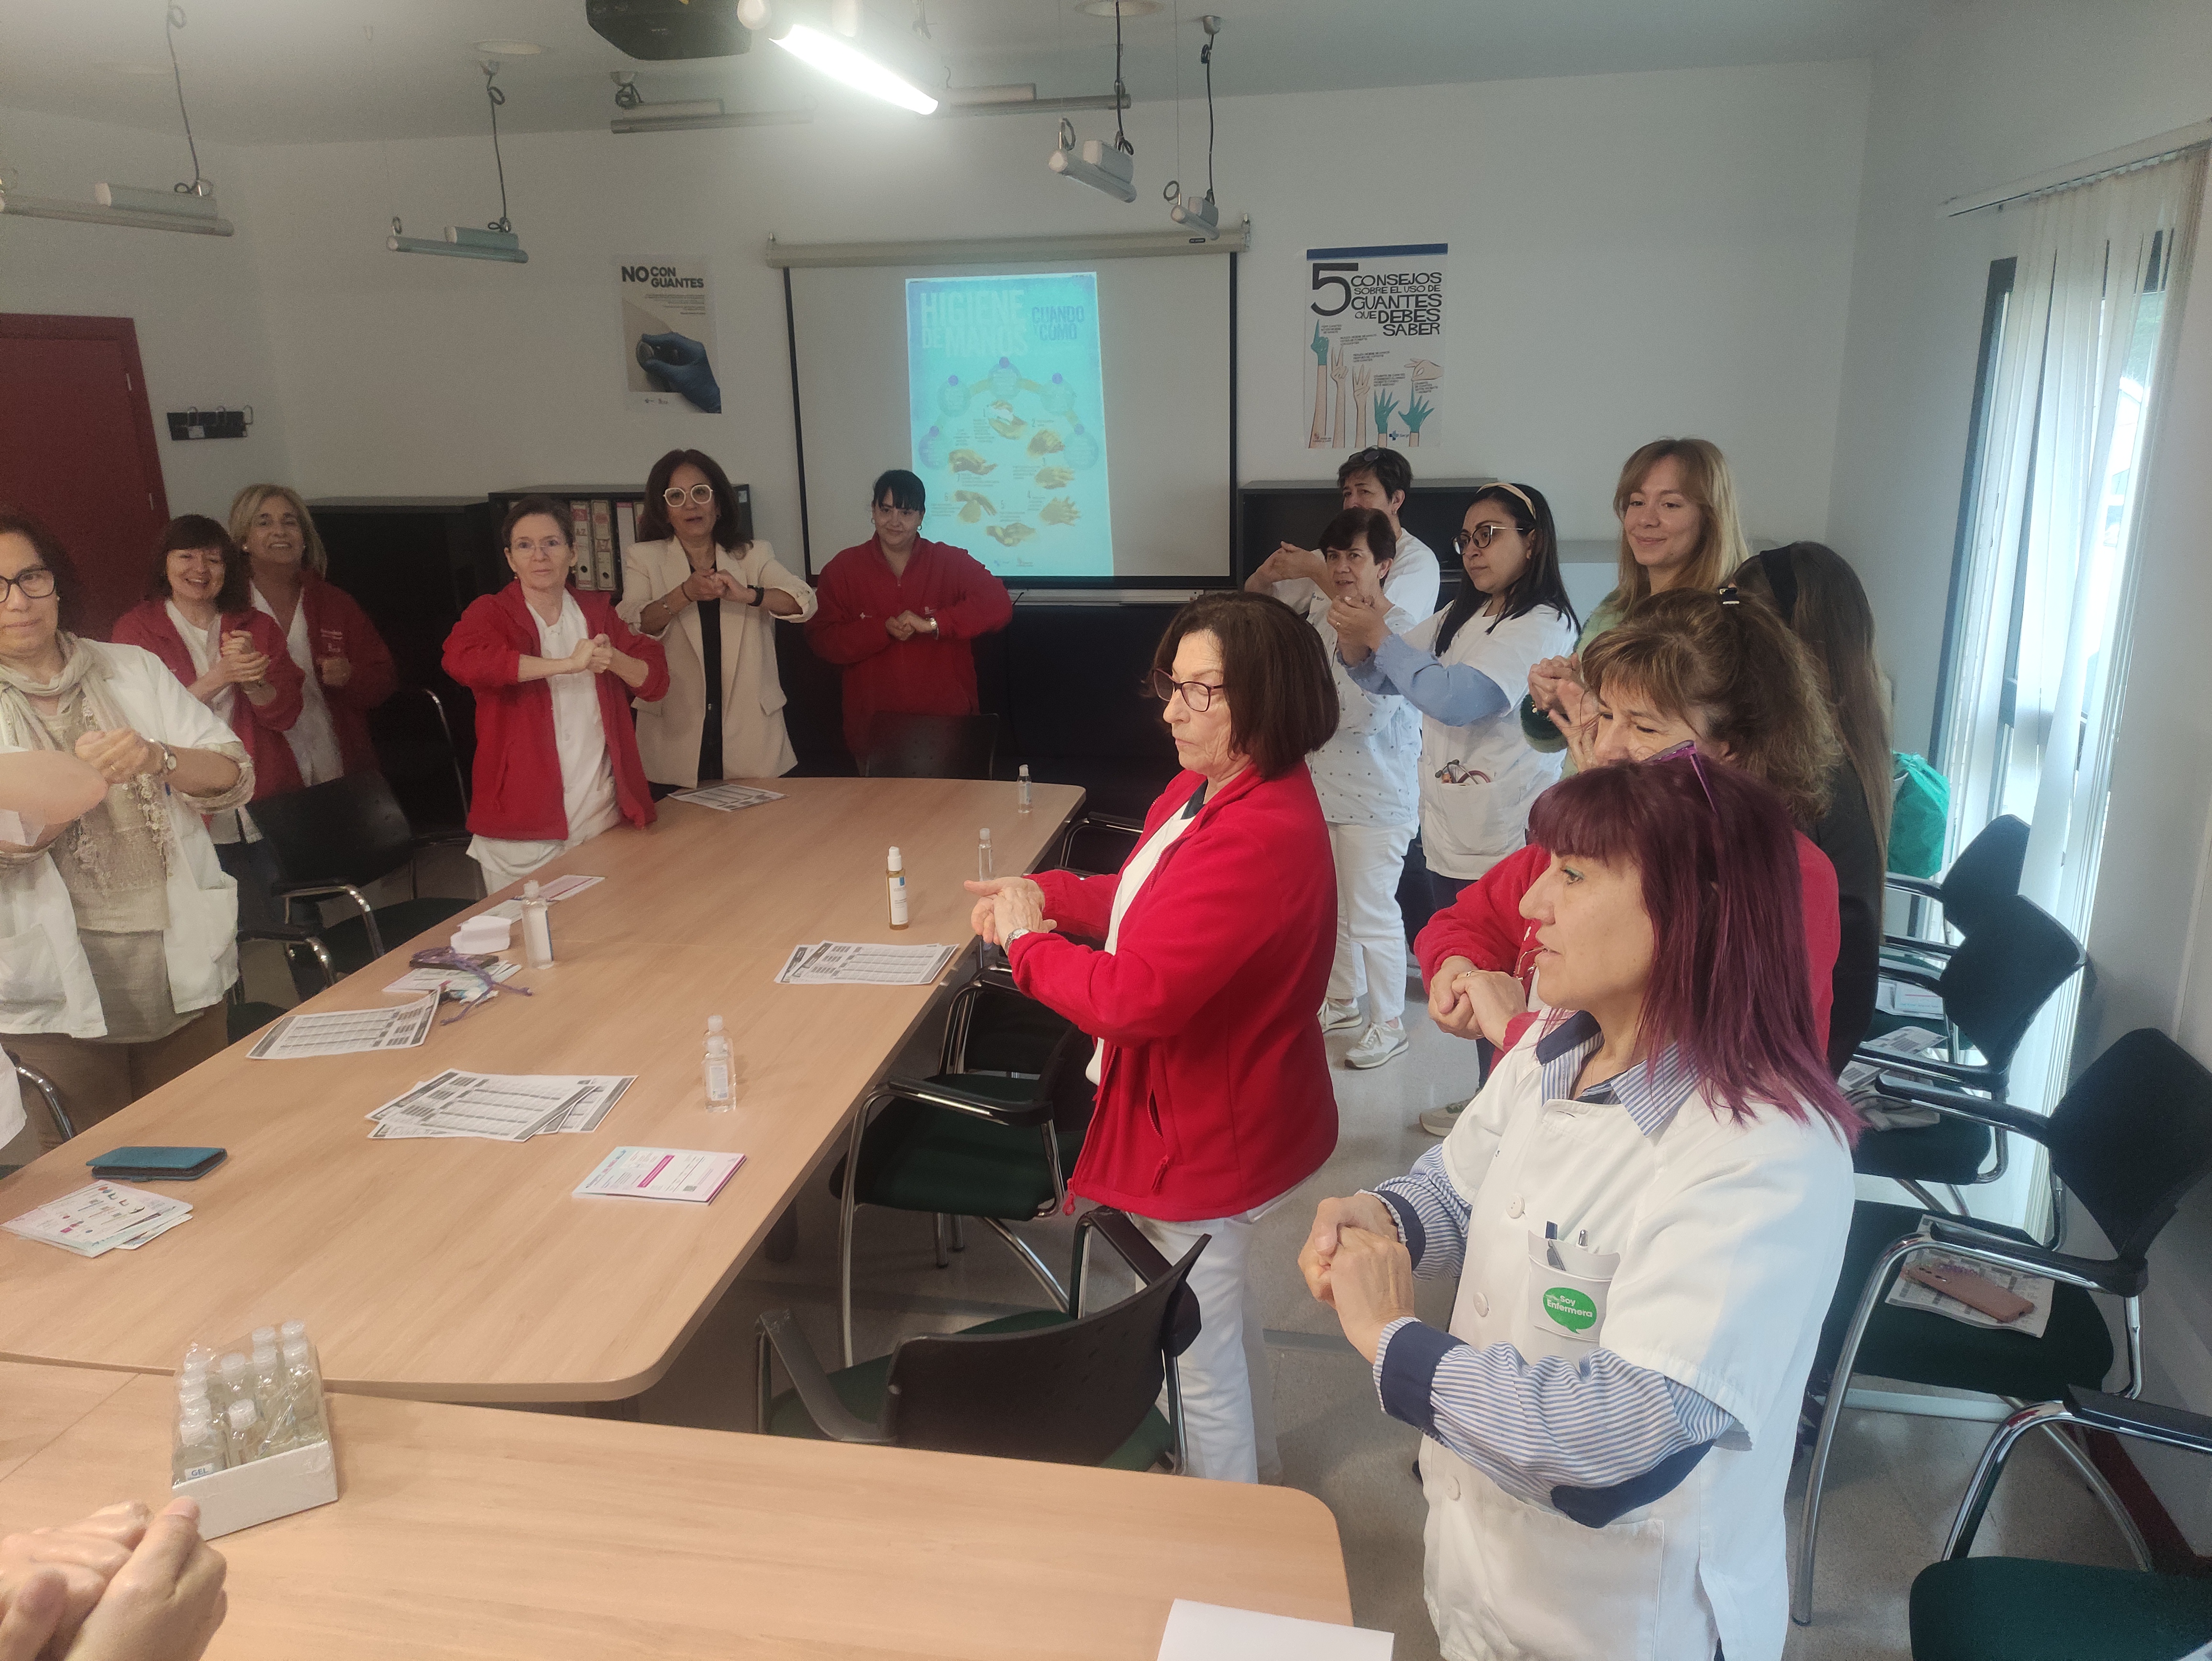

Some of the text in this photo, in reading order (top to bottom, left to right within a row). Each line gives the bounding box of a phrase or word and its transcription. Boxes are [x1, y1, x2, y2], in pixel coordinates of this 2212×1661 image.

[621, 266, 649, 283] NO
[650, 266, 676, 277] CON
[651, 278, 704, 288] GUANTES
[1350, 272, 1442, 287] CONSEJOS
[1311, 263, 1359, 316] 5
[1354, 287, 1388, 295] SOBRE
[920, 290, 1025, 326] HIGIENE
[1351, 293, 1442, 310] GUANTES
[1355, 309, 1440, 324] QUE DEBES
[1382, 322, 1440, 336] SABER
[922, 325, 1029, 358] DE MANOS
[1559, 1295, 1576, 1306] Soy
[1547, 1299, 1593, 1318] Enfermera
[191, 1468, 208, 1476] GEL
